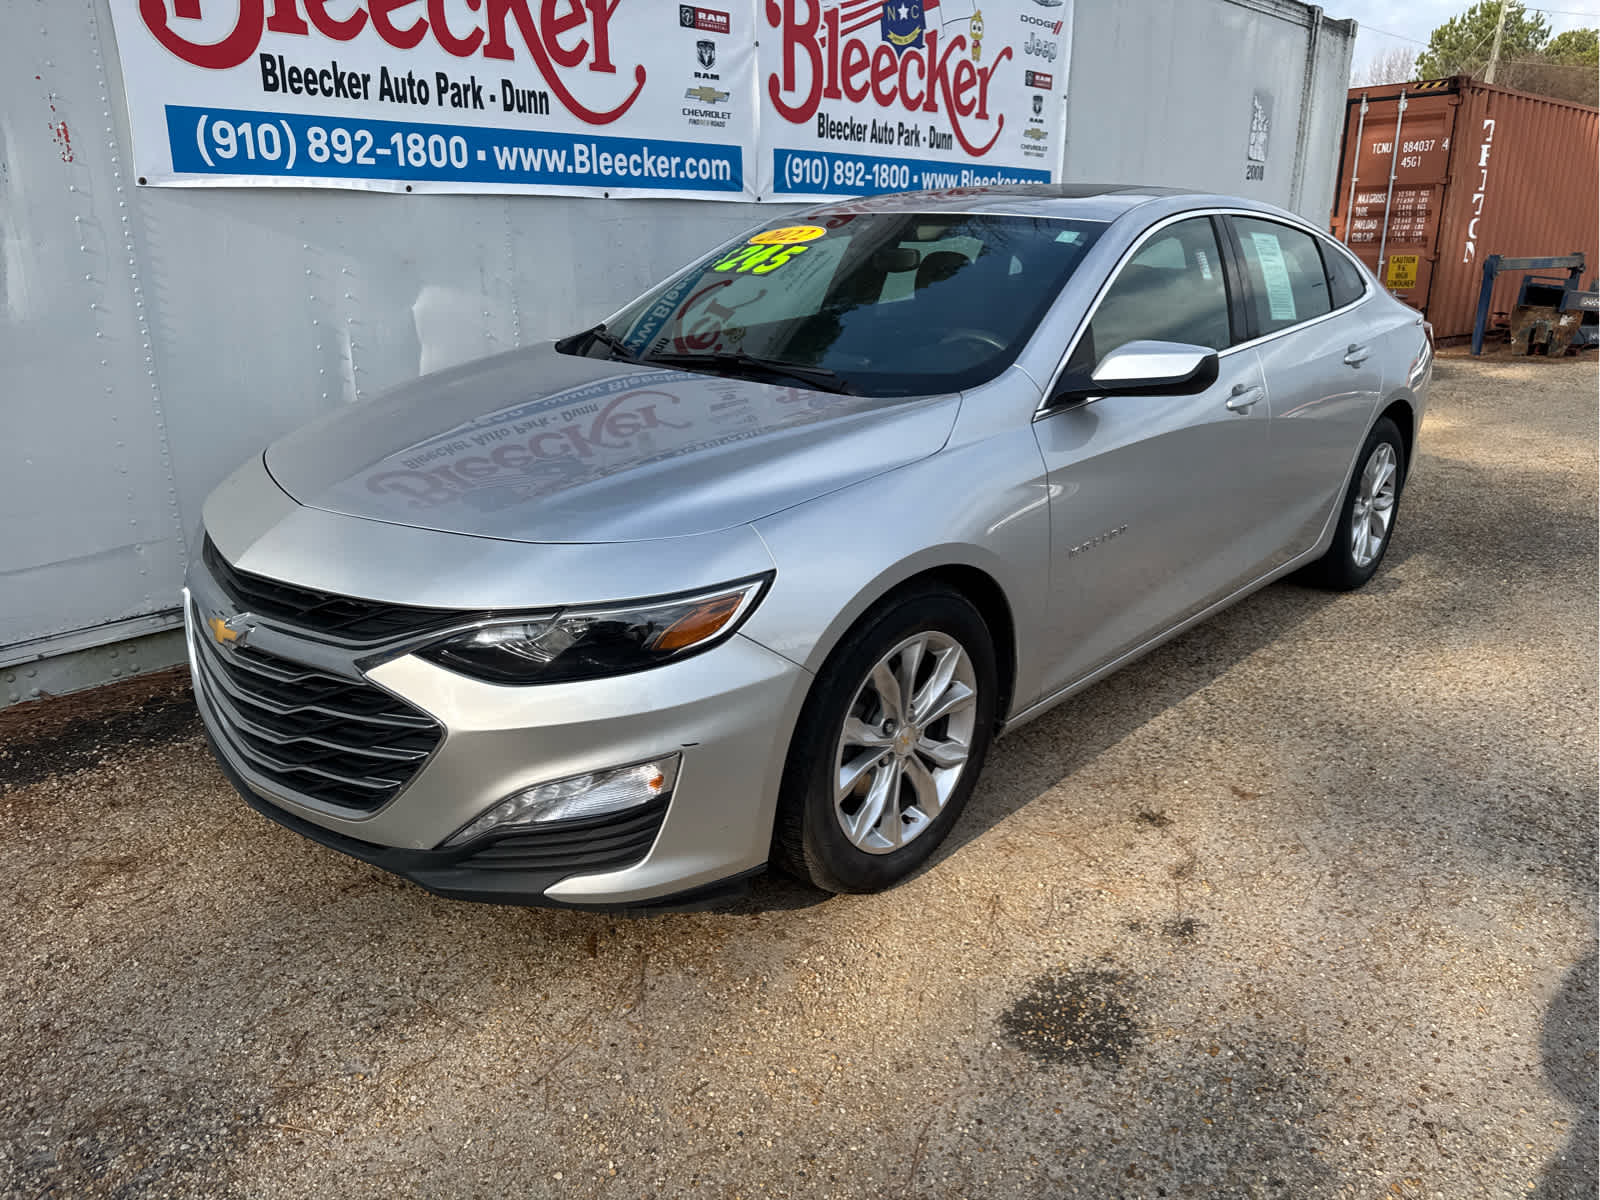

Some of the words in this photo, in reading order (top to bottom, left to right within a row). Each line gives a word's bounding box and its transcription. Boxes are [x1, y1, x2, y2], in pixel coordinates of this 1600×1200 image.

[698, 12, 727, 24] RAM
[1020, 14, 1056, 29] DODGE
[1024, 32, 1057, 63] Jeep
[693, 72, 720, 81] RAM
[258, 53, 371, 101] Bleecker
[379, 65, 430, 106] Auto
[435, 72, 485, 110] Park
[502, 79, 551, 116] Dunn
[682, 107, 733, 120] CHEVROLET
[817, 112, 869, 142] Bleecker
[870, 124, 895, 147] Auto
[897, 121, 921, 149] Park
[928, 128, 953, 151] Dunn
[196, 114, 297, 170] (910)
[307, 125, 469, 169] 892-1800
[494, 141, 733, 182] www.Bleecker.com
[1372, 142, 1393, 154] TCNU
[1402, 140, 1436, 153] 884037
[1400, 155, 1422, 169] 45G1
[784, 153, 830, 190] (910)
[833, 160, 910, 189] 892-1800
